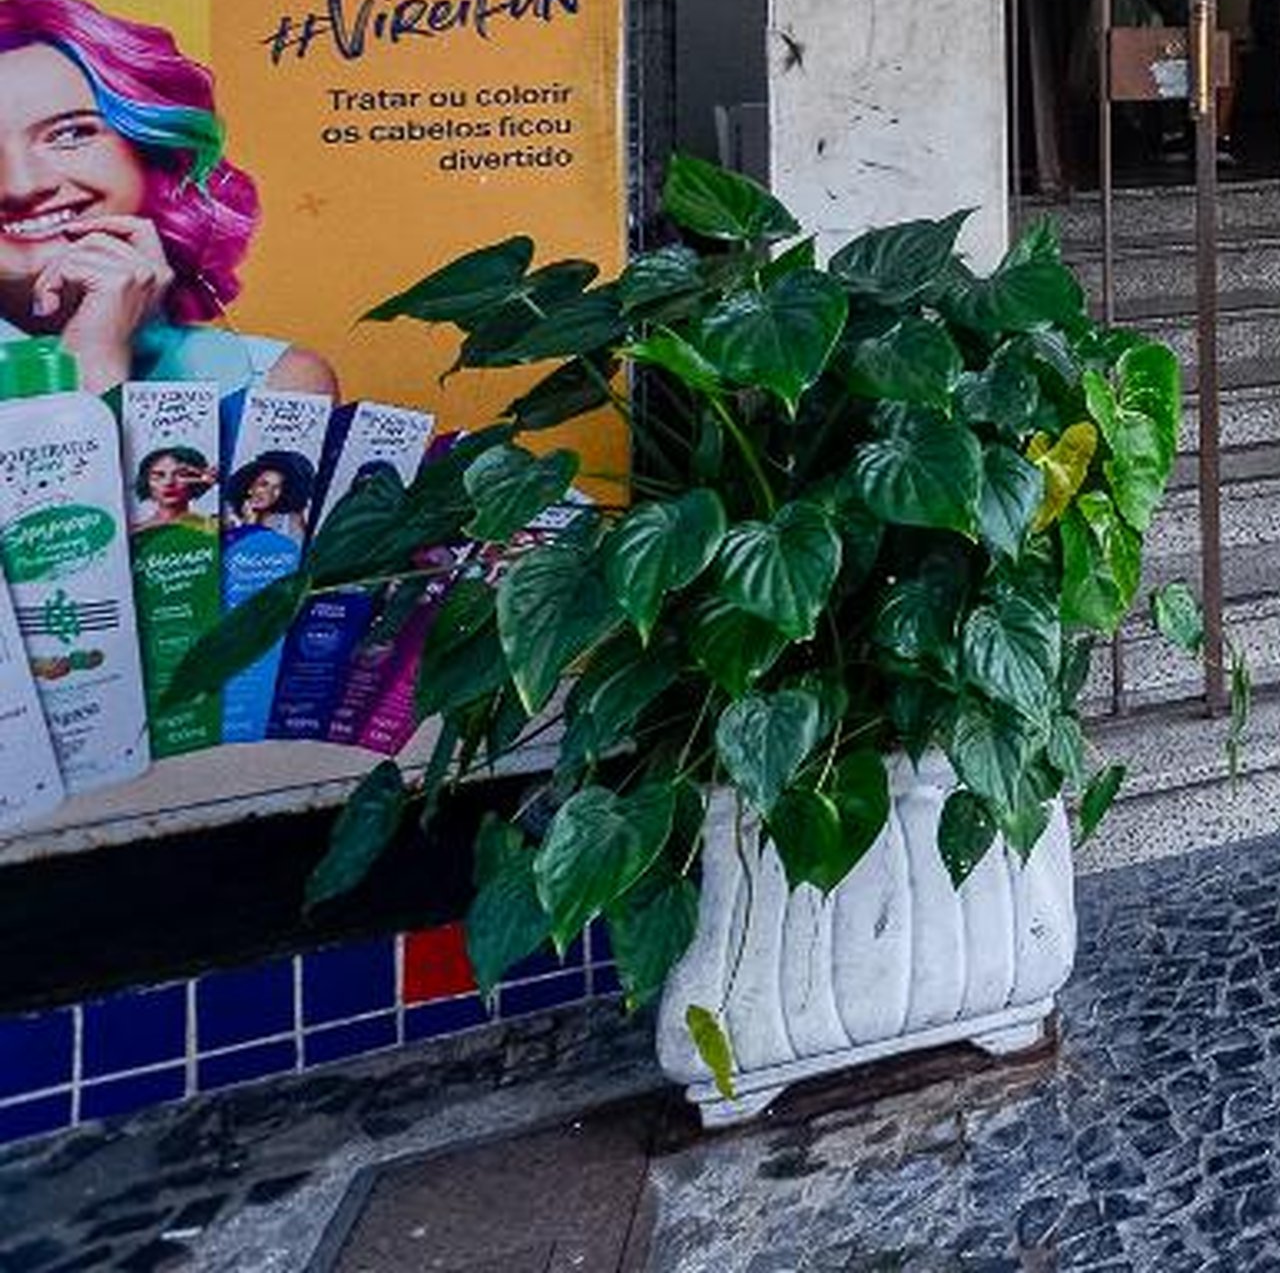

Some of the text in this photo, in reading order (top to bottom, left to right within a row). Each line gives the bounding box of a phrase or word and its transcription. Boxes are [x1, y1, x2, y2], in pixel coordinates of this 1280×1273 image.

[327, 82, 573, 112] Tratar ou colorir
[321, 116, 572, 145] os cabelos ficou
[438, 146, 573, 172] divertido
